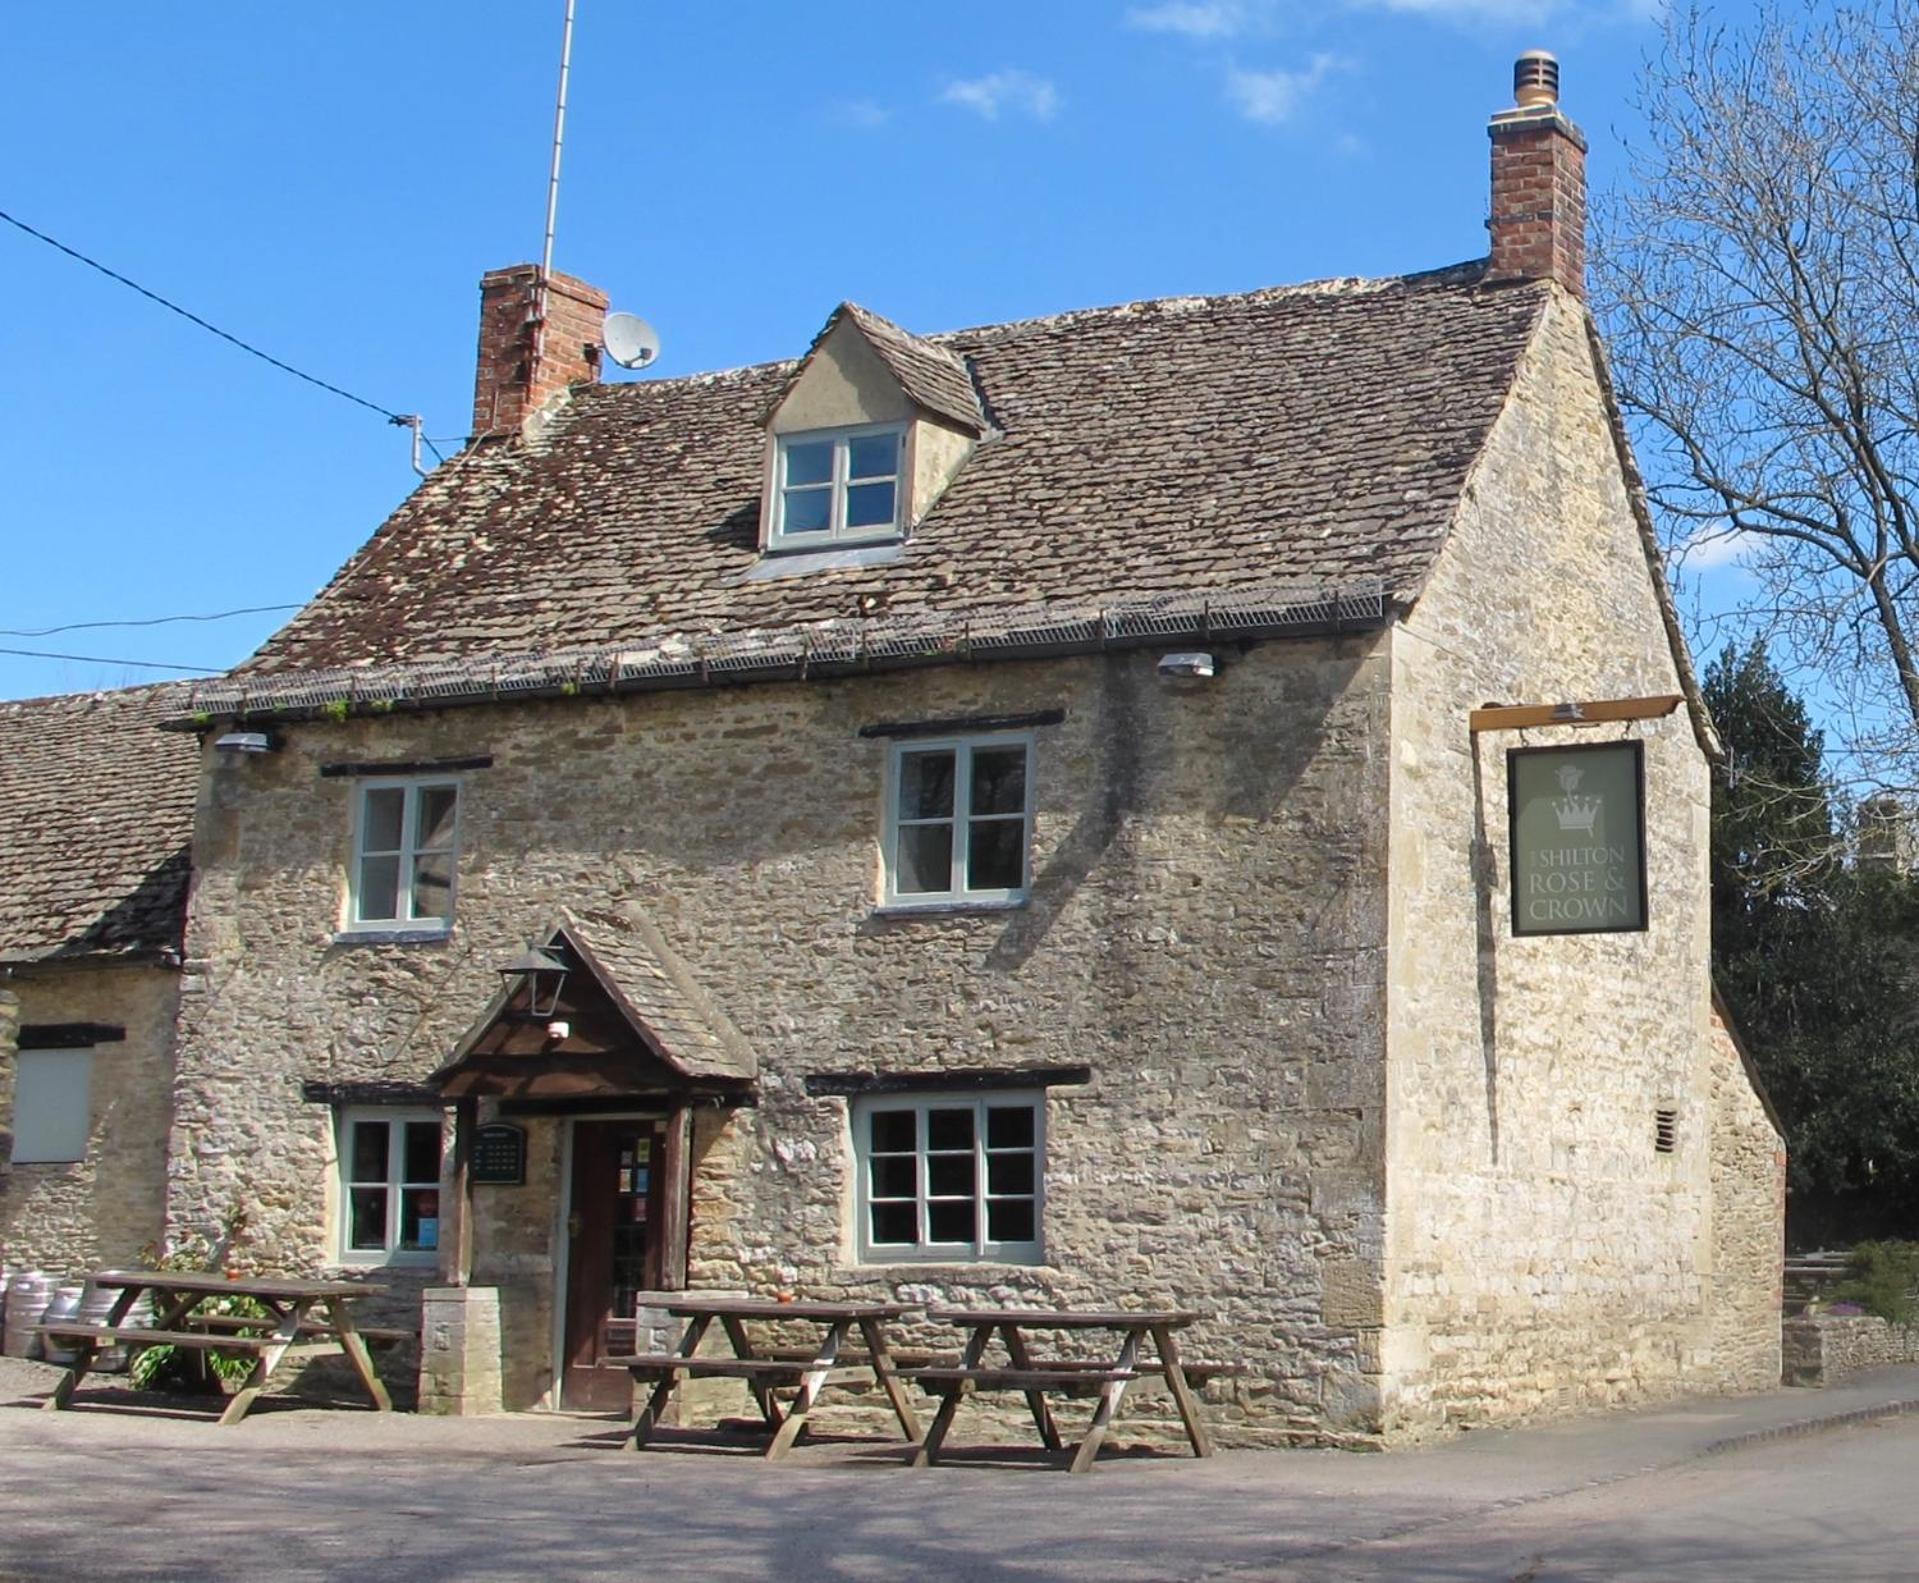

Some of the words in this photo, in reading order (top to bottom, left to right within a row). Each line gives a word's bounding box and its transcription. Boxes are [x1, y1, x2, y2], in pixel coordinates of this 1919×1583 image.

[1539, 847, 1625, 867] SHILTON
[1530, 871, 1595, 894] ROSE
[1605, 867, 1625, 891] &
[1530, 897, 1627, 920] CROWN
